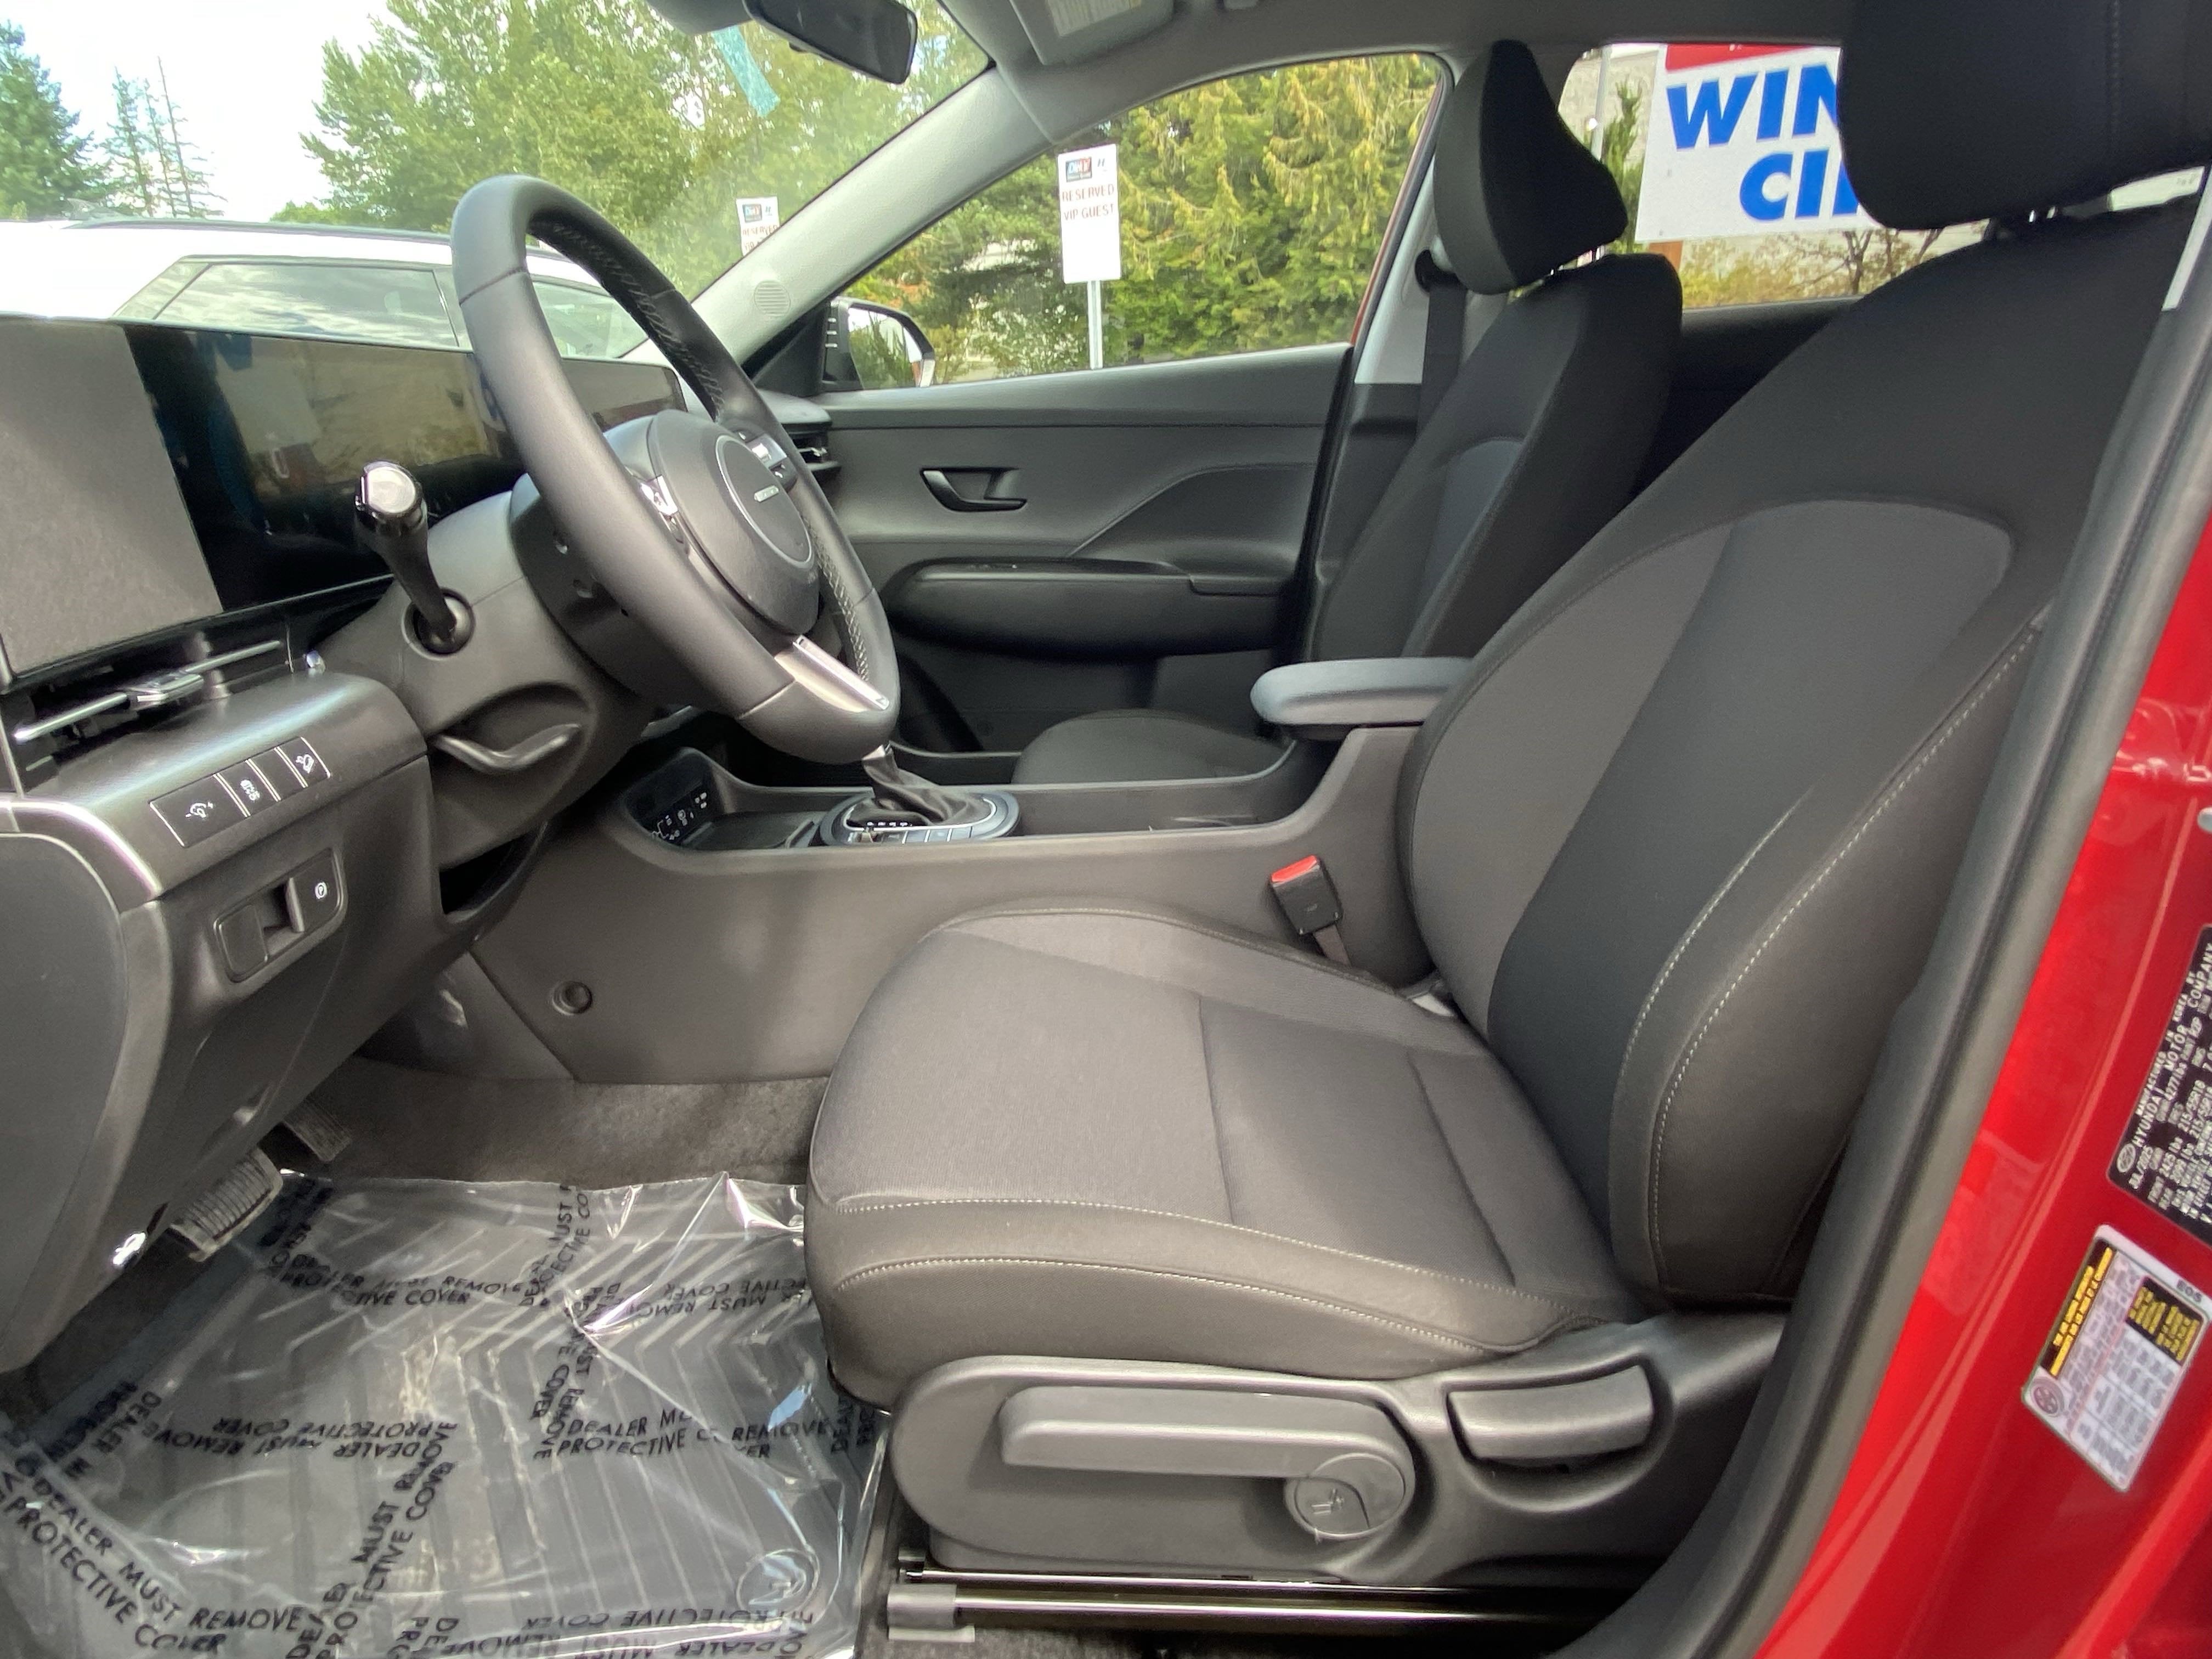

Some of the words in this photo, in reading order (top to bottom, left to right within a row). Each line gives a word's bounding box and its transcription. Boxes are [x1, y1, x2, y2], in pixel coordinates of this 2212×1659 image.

[1062, 184, 1114, 202] RESERVED
[1064, 208, 1078, 221] VIP
[1081, 203, 1113, 219] GUEST
[2132, 1086, 2165, 1147] HYUNDAI
[2163, 1024, 2187, 1070] MOTOR
[567, 1417, 648, 1436] DEALER
[334, 1442, 421, 1458] DEALER
[556, 1429, 687, 1458] PROTECTIVE
[351, 1501, 399, 1564] MUST
[4, 1496, 138, 1624] PROTECTIVE
[32, 1476, 113, 1556] DEALER
[119, 1561, 181, 1622] MUST
[189, 1605, 303, 1631] REMOVE
